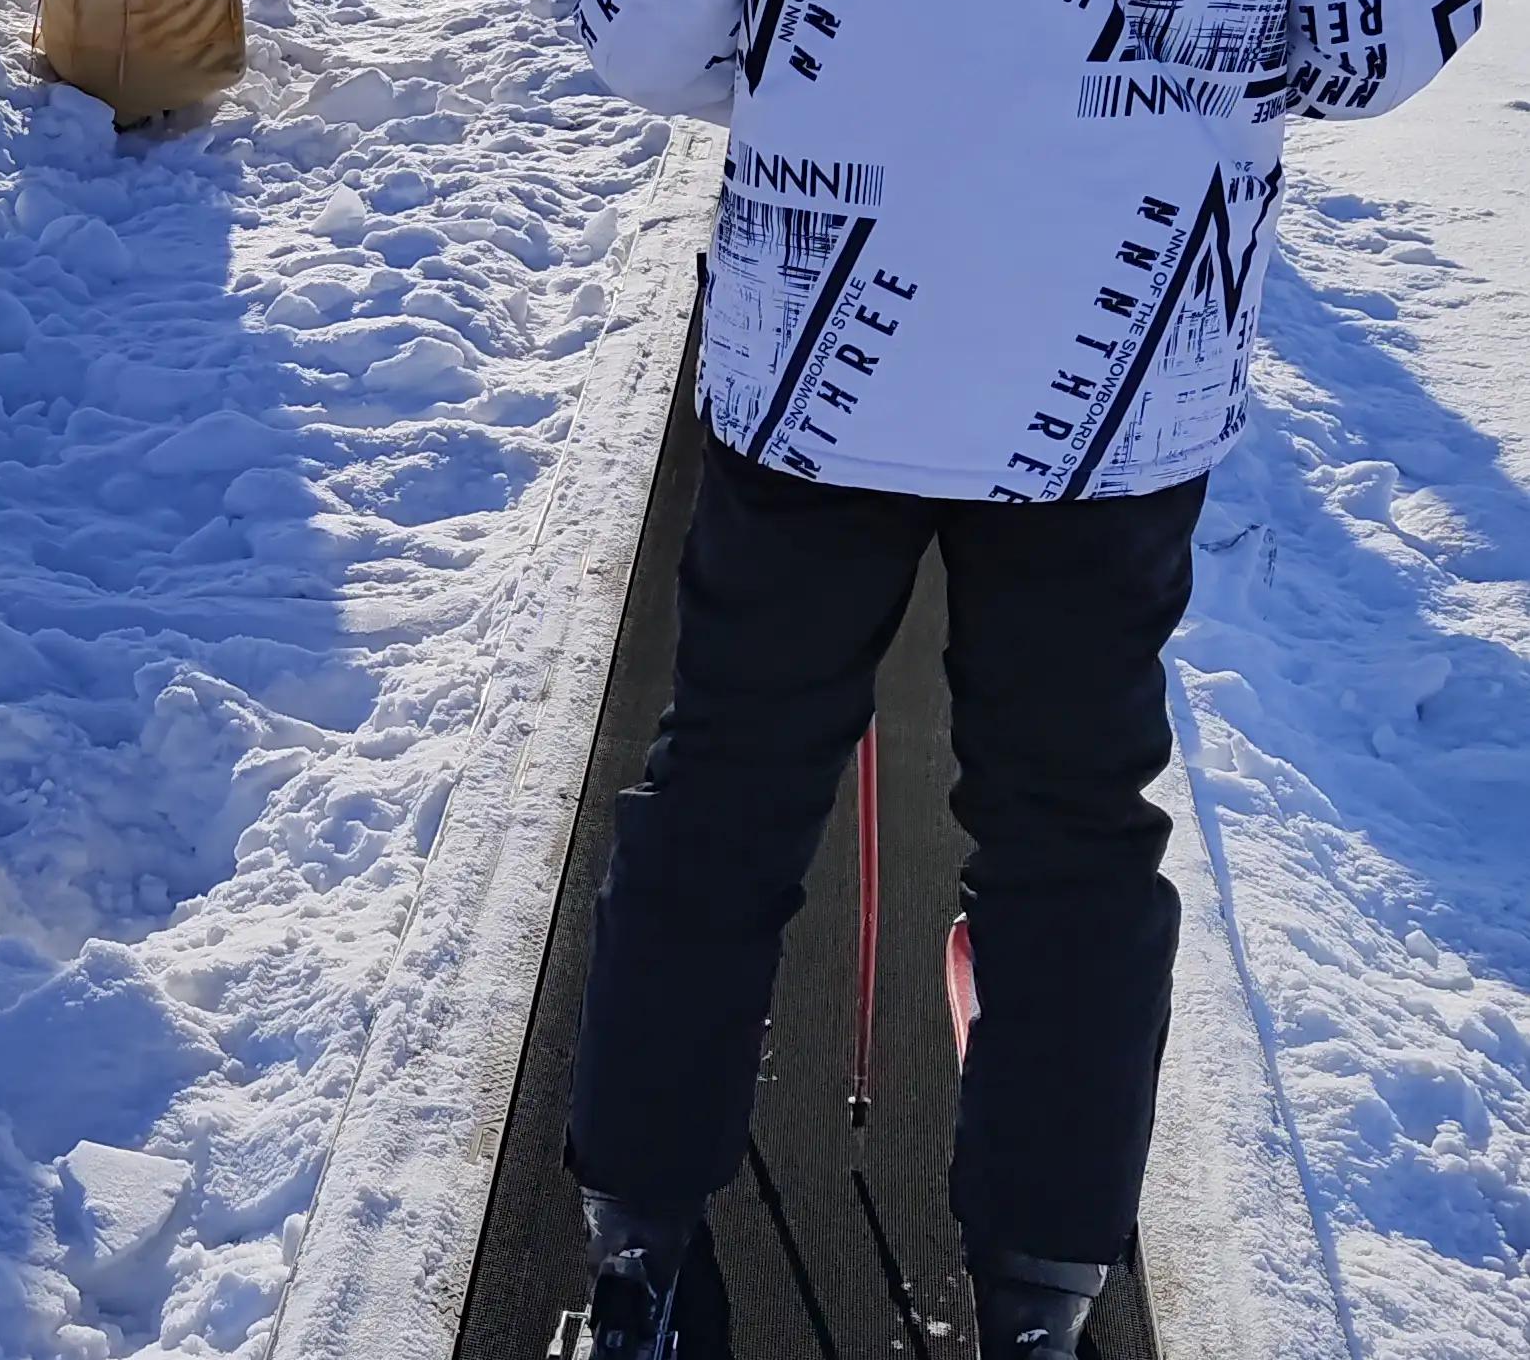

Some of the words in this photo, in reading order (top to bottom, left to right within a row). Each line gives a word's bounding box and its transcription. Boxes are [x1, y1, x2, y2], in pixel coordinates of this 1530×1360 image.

[778, 4, 802, 43] NNN
[754, 151, 841, 200] NNN
[1164, 228, 1188, 270] NNN
[1150, 272, 1169, 299] OF
[1129, 302, 1157, 337] THE
[766, 428, 791, 464] THE
[783, 330, 839, 430] SNOWBOARD
[833, 276, 868, 332] STYLE
[1070, 339, 1138, 452] SNOWBOARD
[1039, 451, 1078, 501] STYLE
